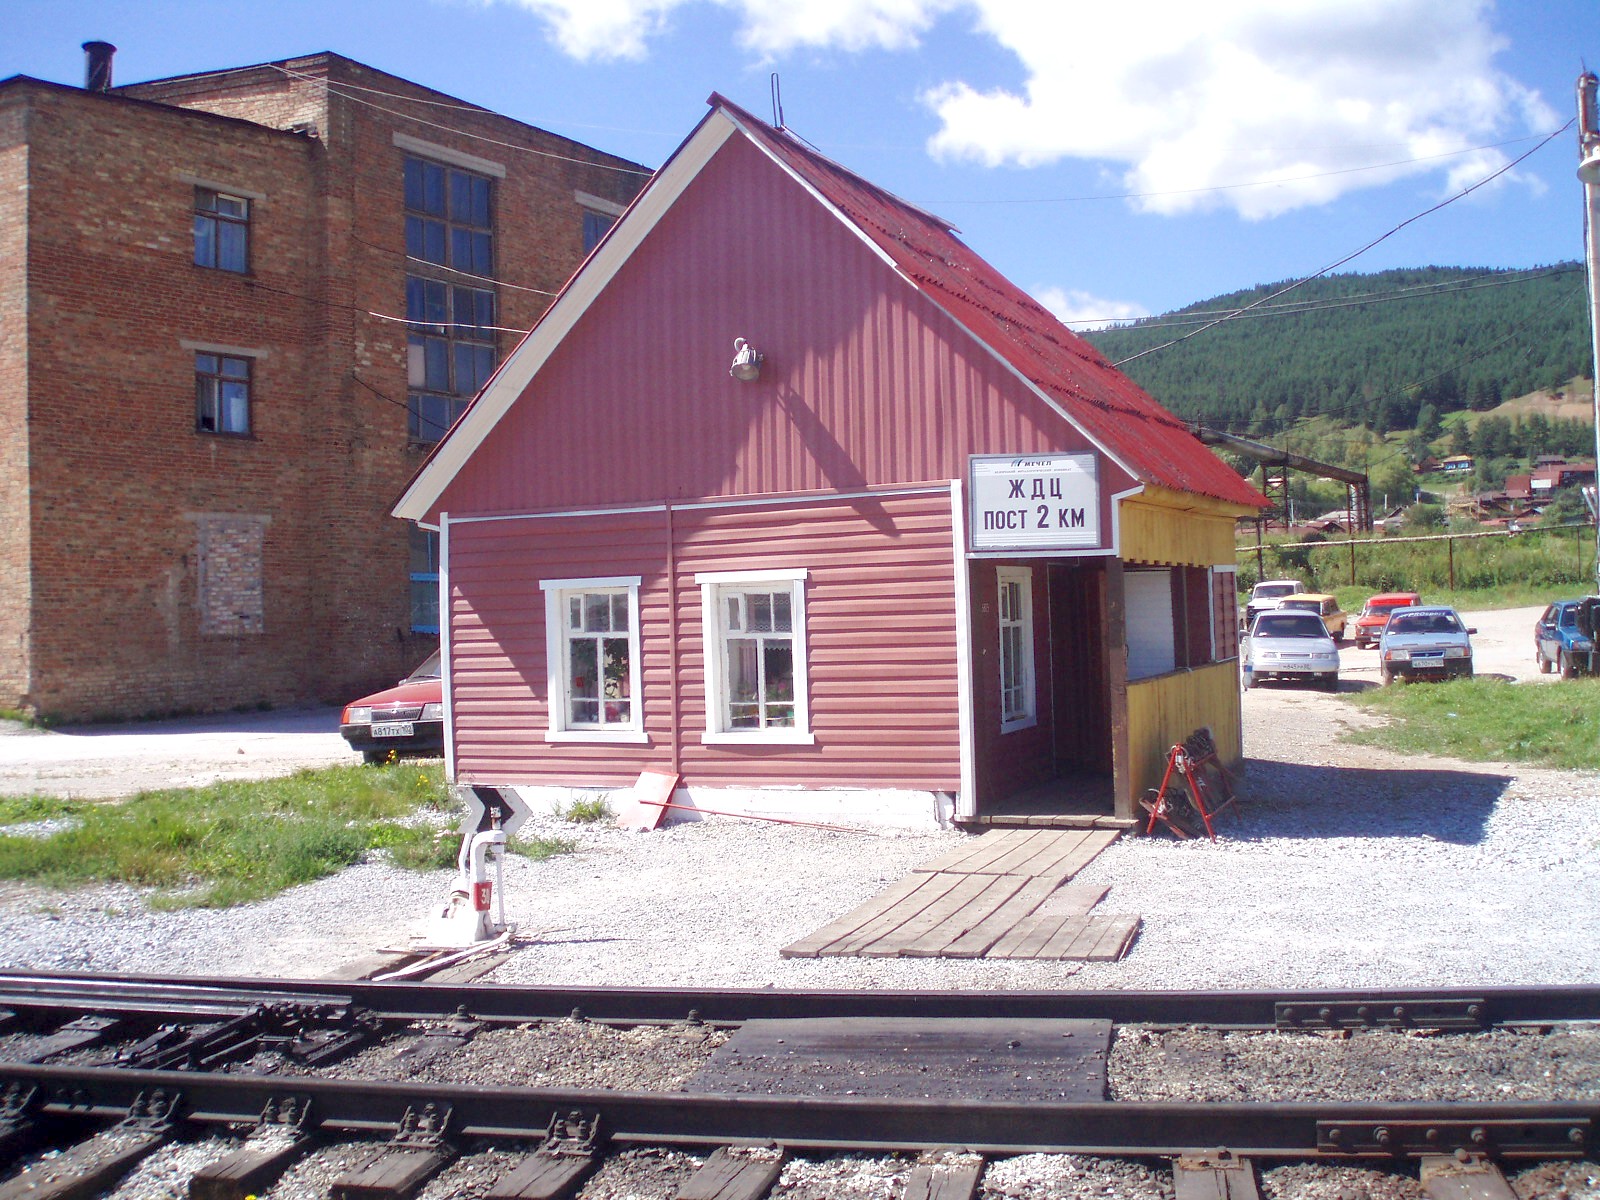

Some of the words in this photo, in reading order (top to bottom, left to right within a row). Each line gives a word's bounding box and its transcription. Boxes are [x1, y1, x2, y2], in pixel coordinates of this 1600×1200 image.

[1008, 478, 1062, 500] ЖДЦ
[984, 509, 1028, 530] ПОСТ
[1036, 504, 1050, 529] 2
[1058, 507, 1085, 528] КМ
